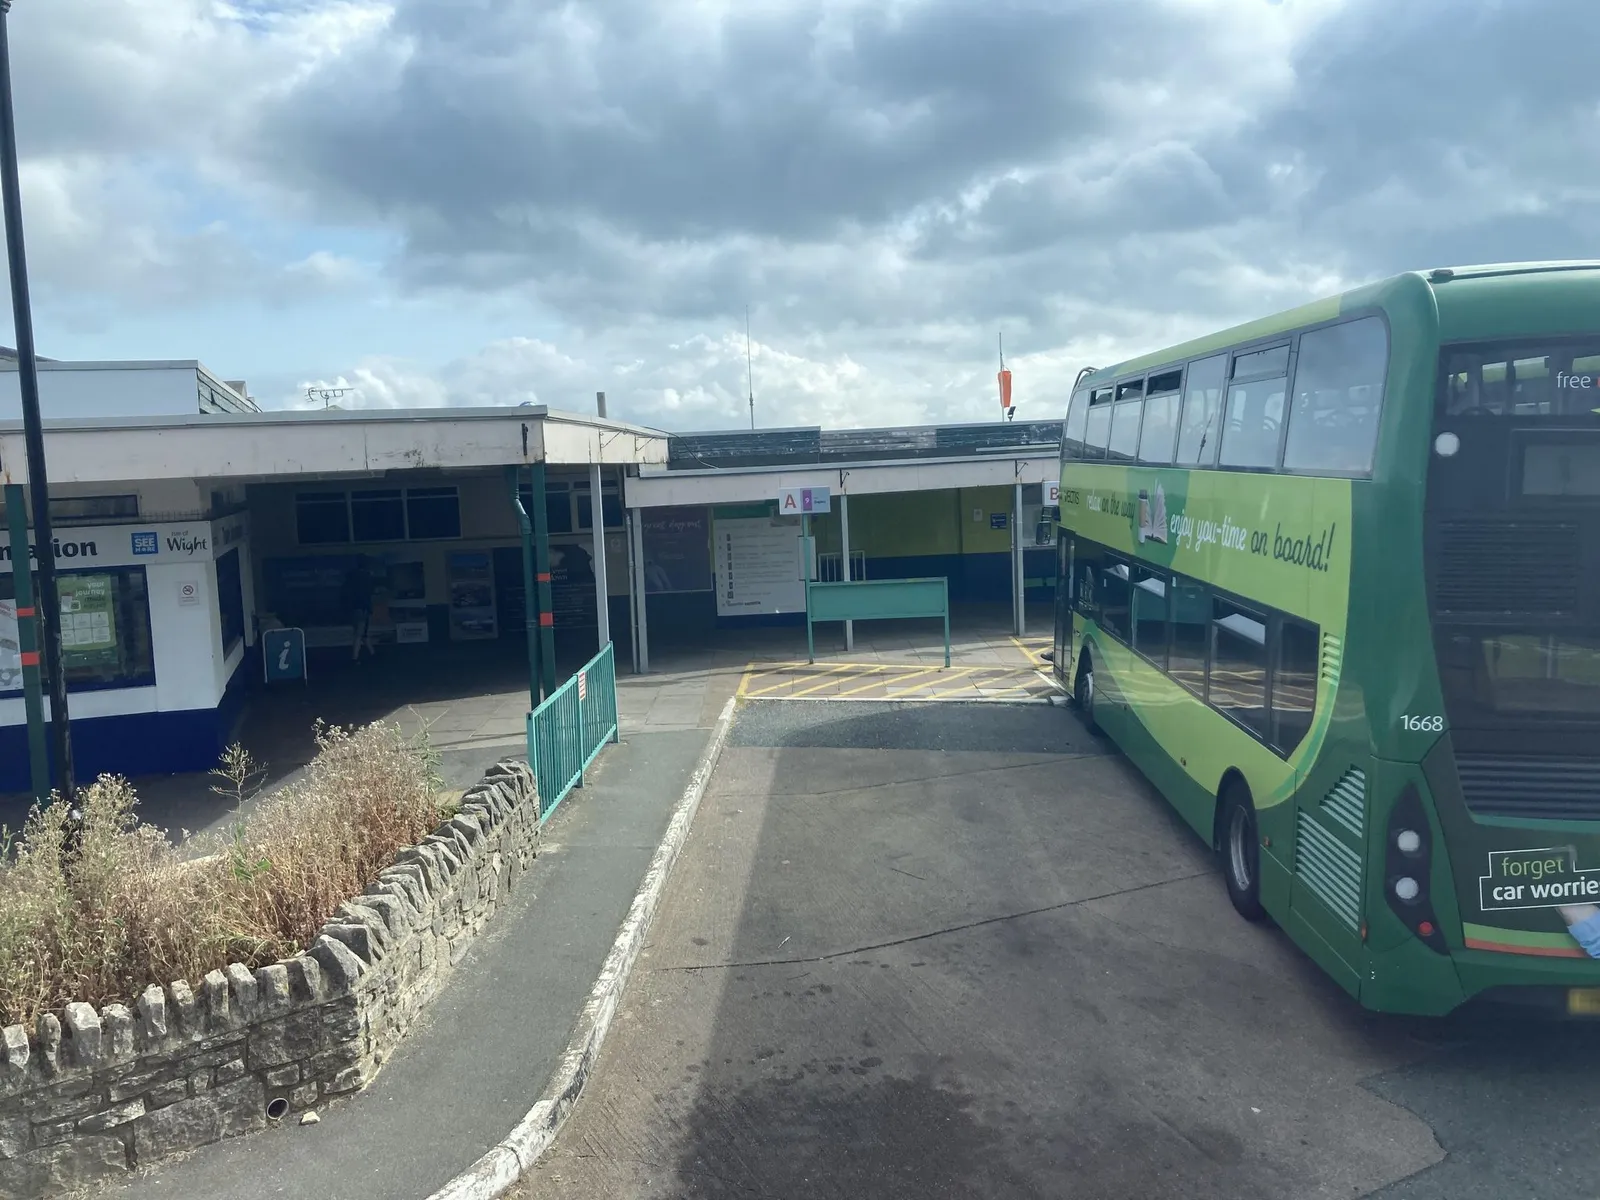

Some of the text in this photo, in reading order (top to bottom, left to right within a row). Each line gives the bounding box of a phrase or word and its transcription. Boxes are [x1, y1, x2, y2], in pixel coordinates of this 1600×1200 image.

[1556, 371, 1591, 389] free
[784, 493, 797, 508] A
[1050, 488, 1059, 500] B
[134, 537, 155, 547] SEE
[166, 536, 207, 556] Wight
[1170, 509, 1336, 572] enjoy you-time on board!
[75, 588, 105, 598] journey
[1400, 714, 1443, 731] 1668
[1501, 856, 1564, 880] forget
[1492, 876, 1600, 901] car worrie
